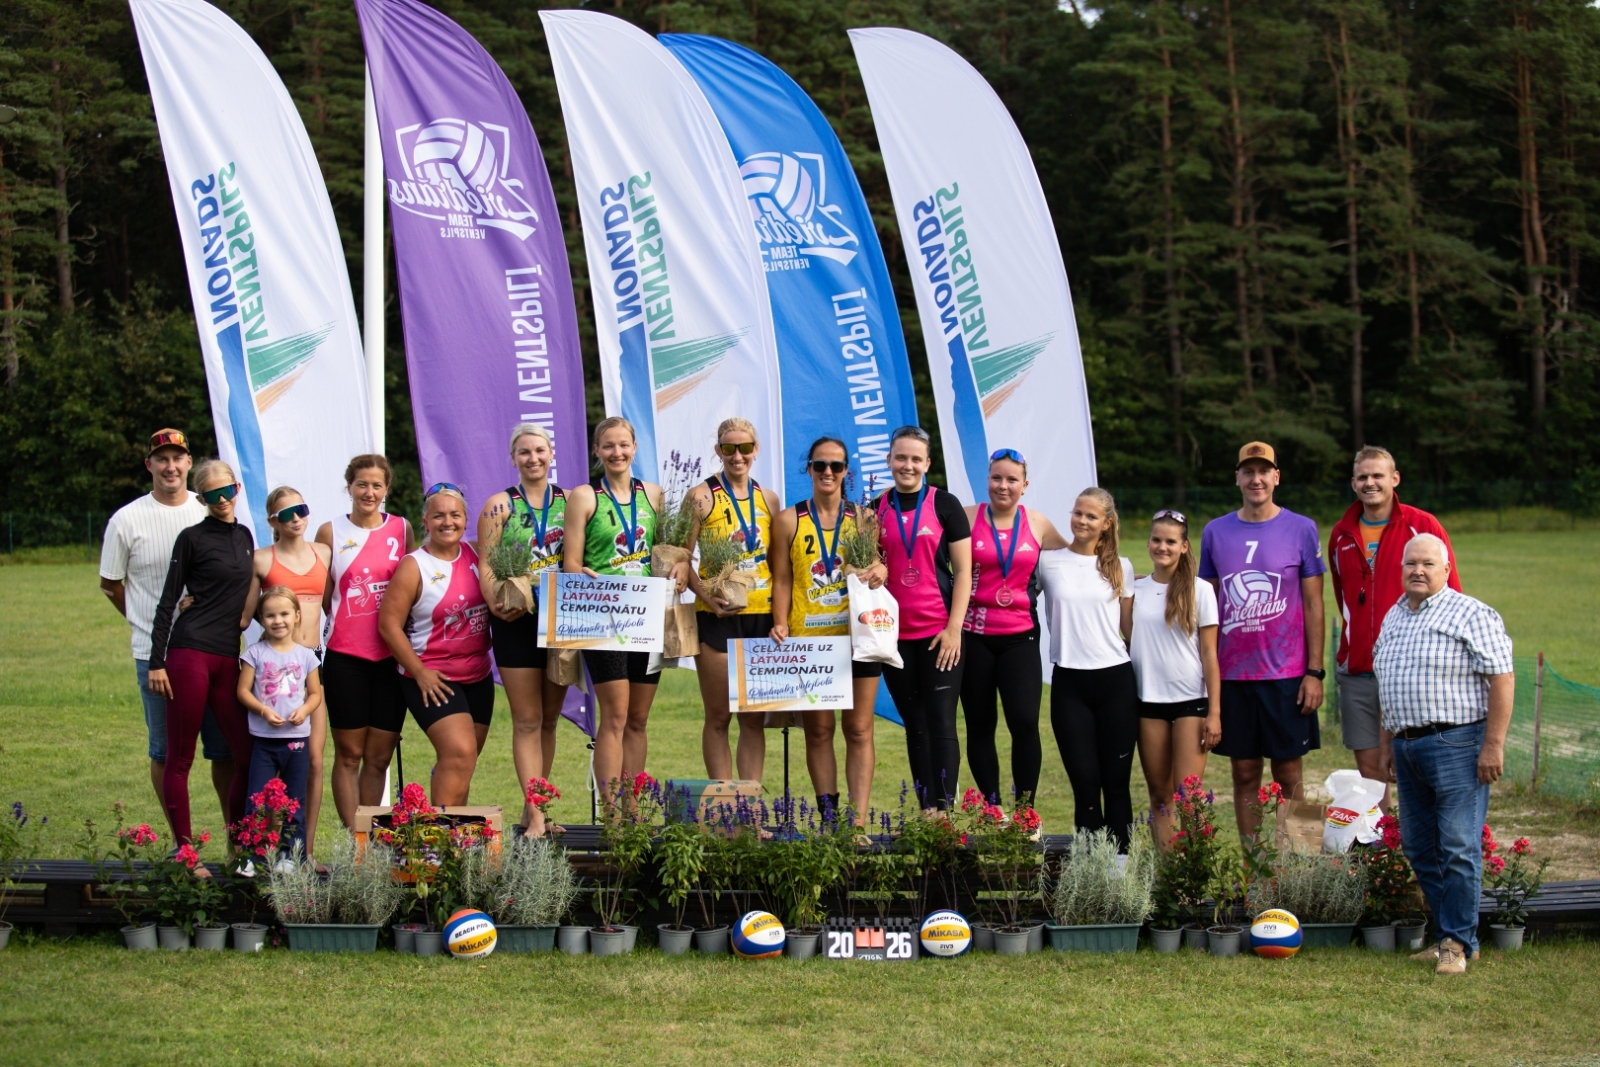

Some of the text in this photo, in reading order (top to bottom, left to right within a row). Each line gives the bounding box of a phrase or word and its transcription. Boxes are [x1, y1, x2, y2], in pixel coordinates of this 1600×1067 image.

[521, 512, 533, 529] 2
[607, 509, 616, 527] 1
[723, 507, 733, 525] 1
[386, 537, 399, 562] 2
[804, 534, 816, 555] 2
[1245, 541, 1259, 564] 7
[631, 584, 648, 593] UZ
[562, 592, 620, 603] LATVIJAS
[1244, 618, 1260, 626] TEAM
[1241, 625, 1265, 633] VENTSPILS
[817, 643, 834, 652] UZ
[750, 654, 807, 665] LATVIJAS
[1329, 810, 1357, 823] FANS
[928, 916, 950, 925] BEACH
[454, 926, 476, 939] BEACH
[828, 931, 912, 959] 20 26
